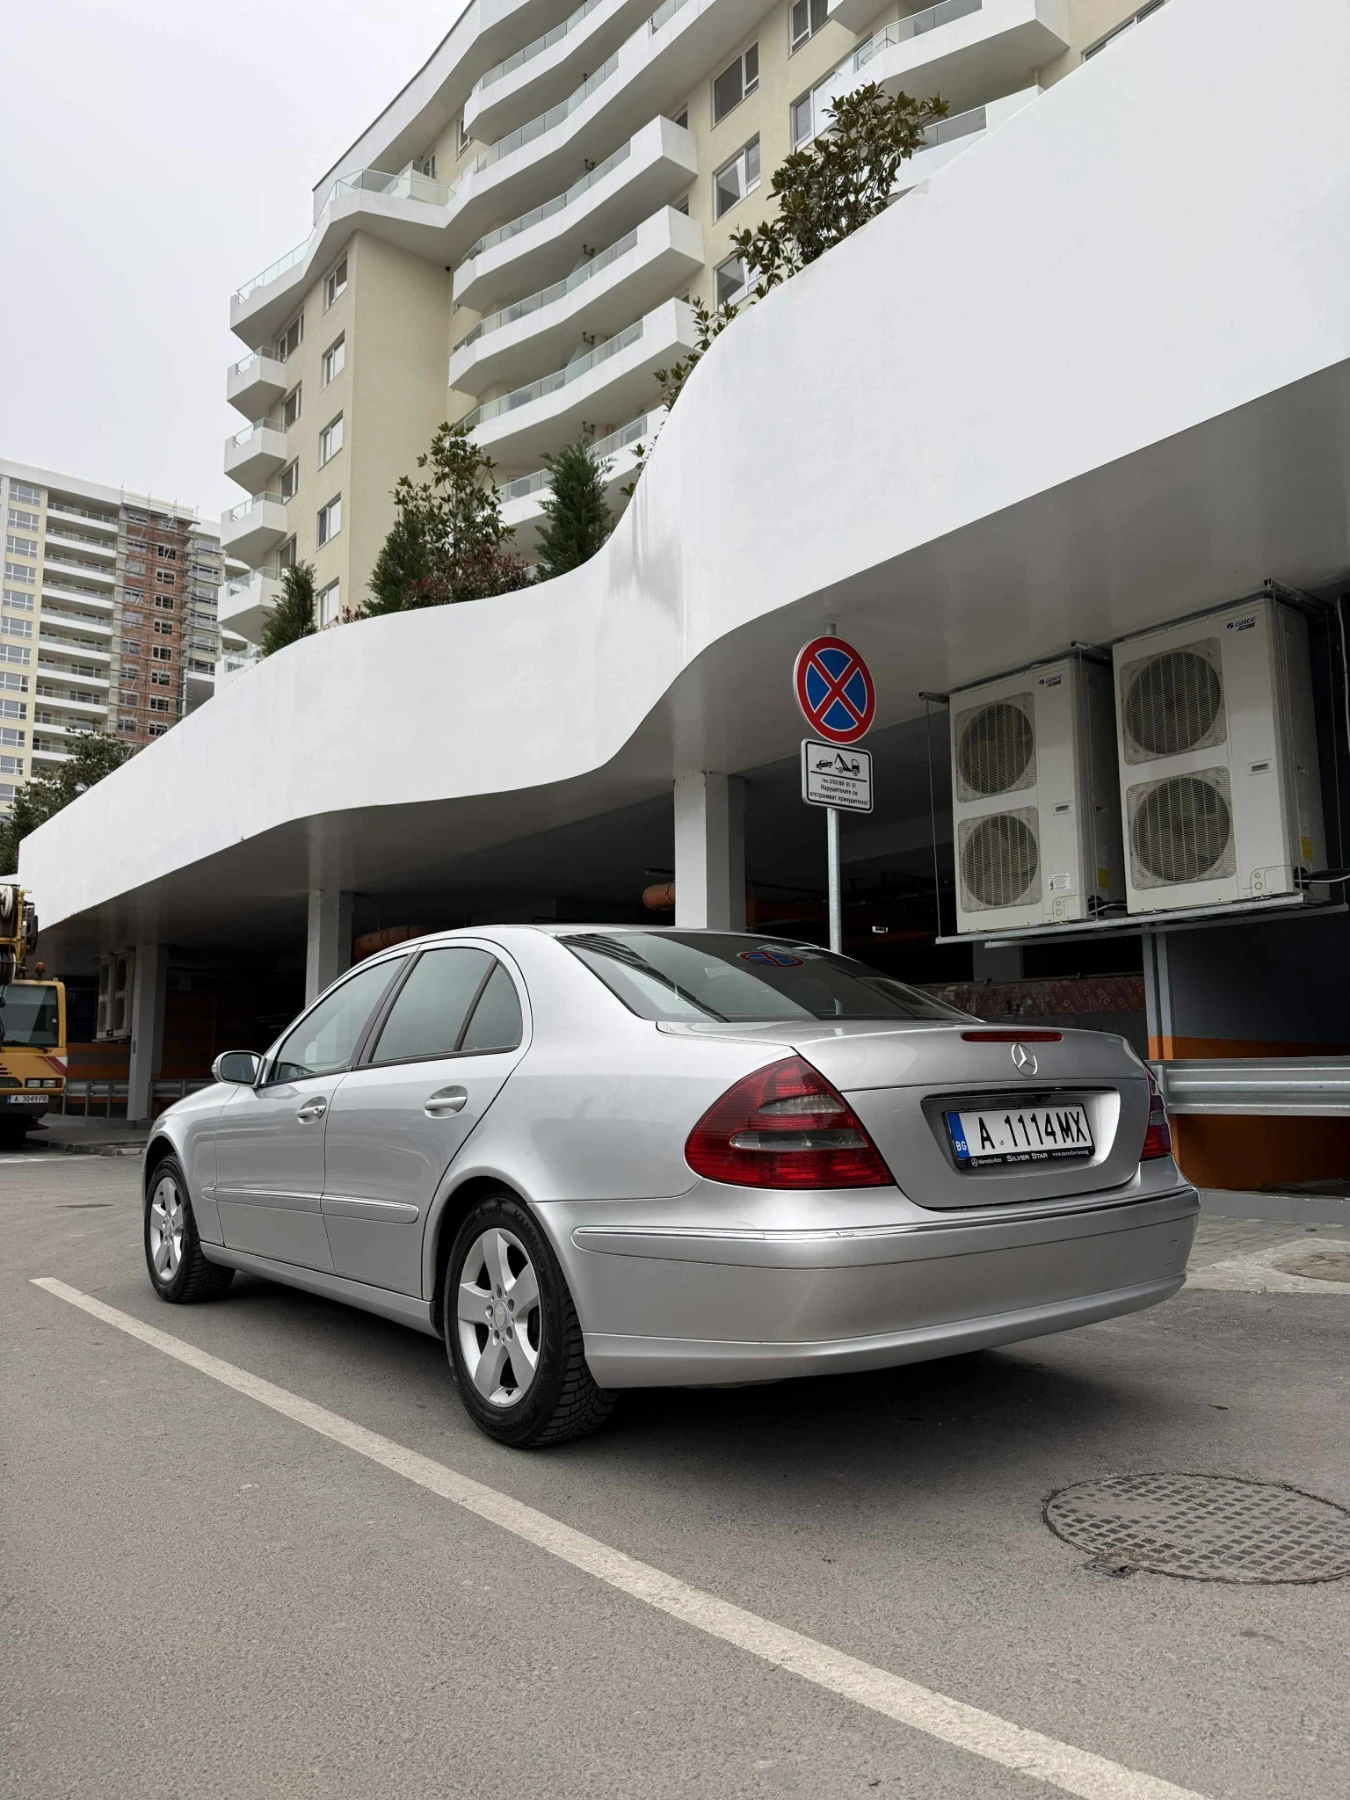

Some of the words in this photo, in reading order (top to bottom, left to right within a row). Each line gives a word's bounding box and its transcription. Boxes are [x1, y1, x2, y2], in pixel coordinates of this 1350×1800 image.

[955, 1140, 967, 1151] BG
[978, 1116, 996, 1150] A
[513, 1209, 547, 1273] KUMHO
